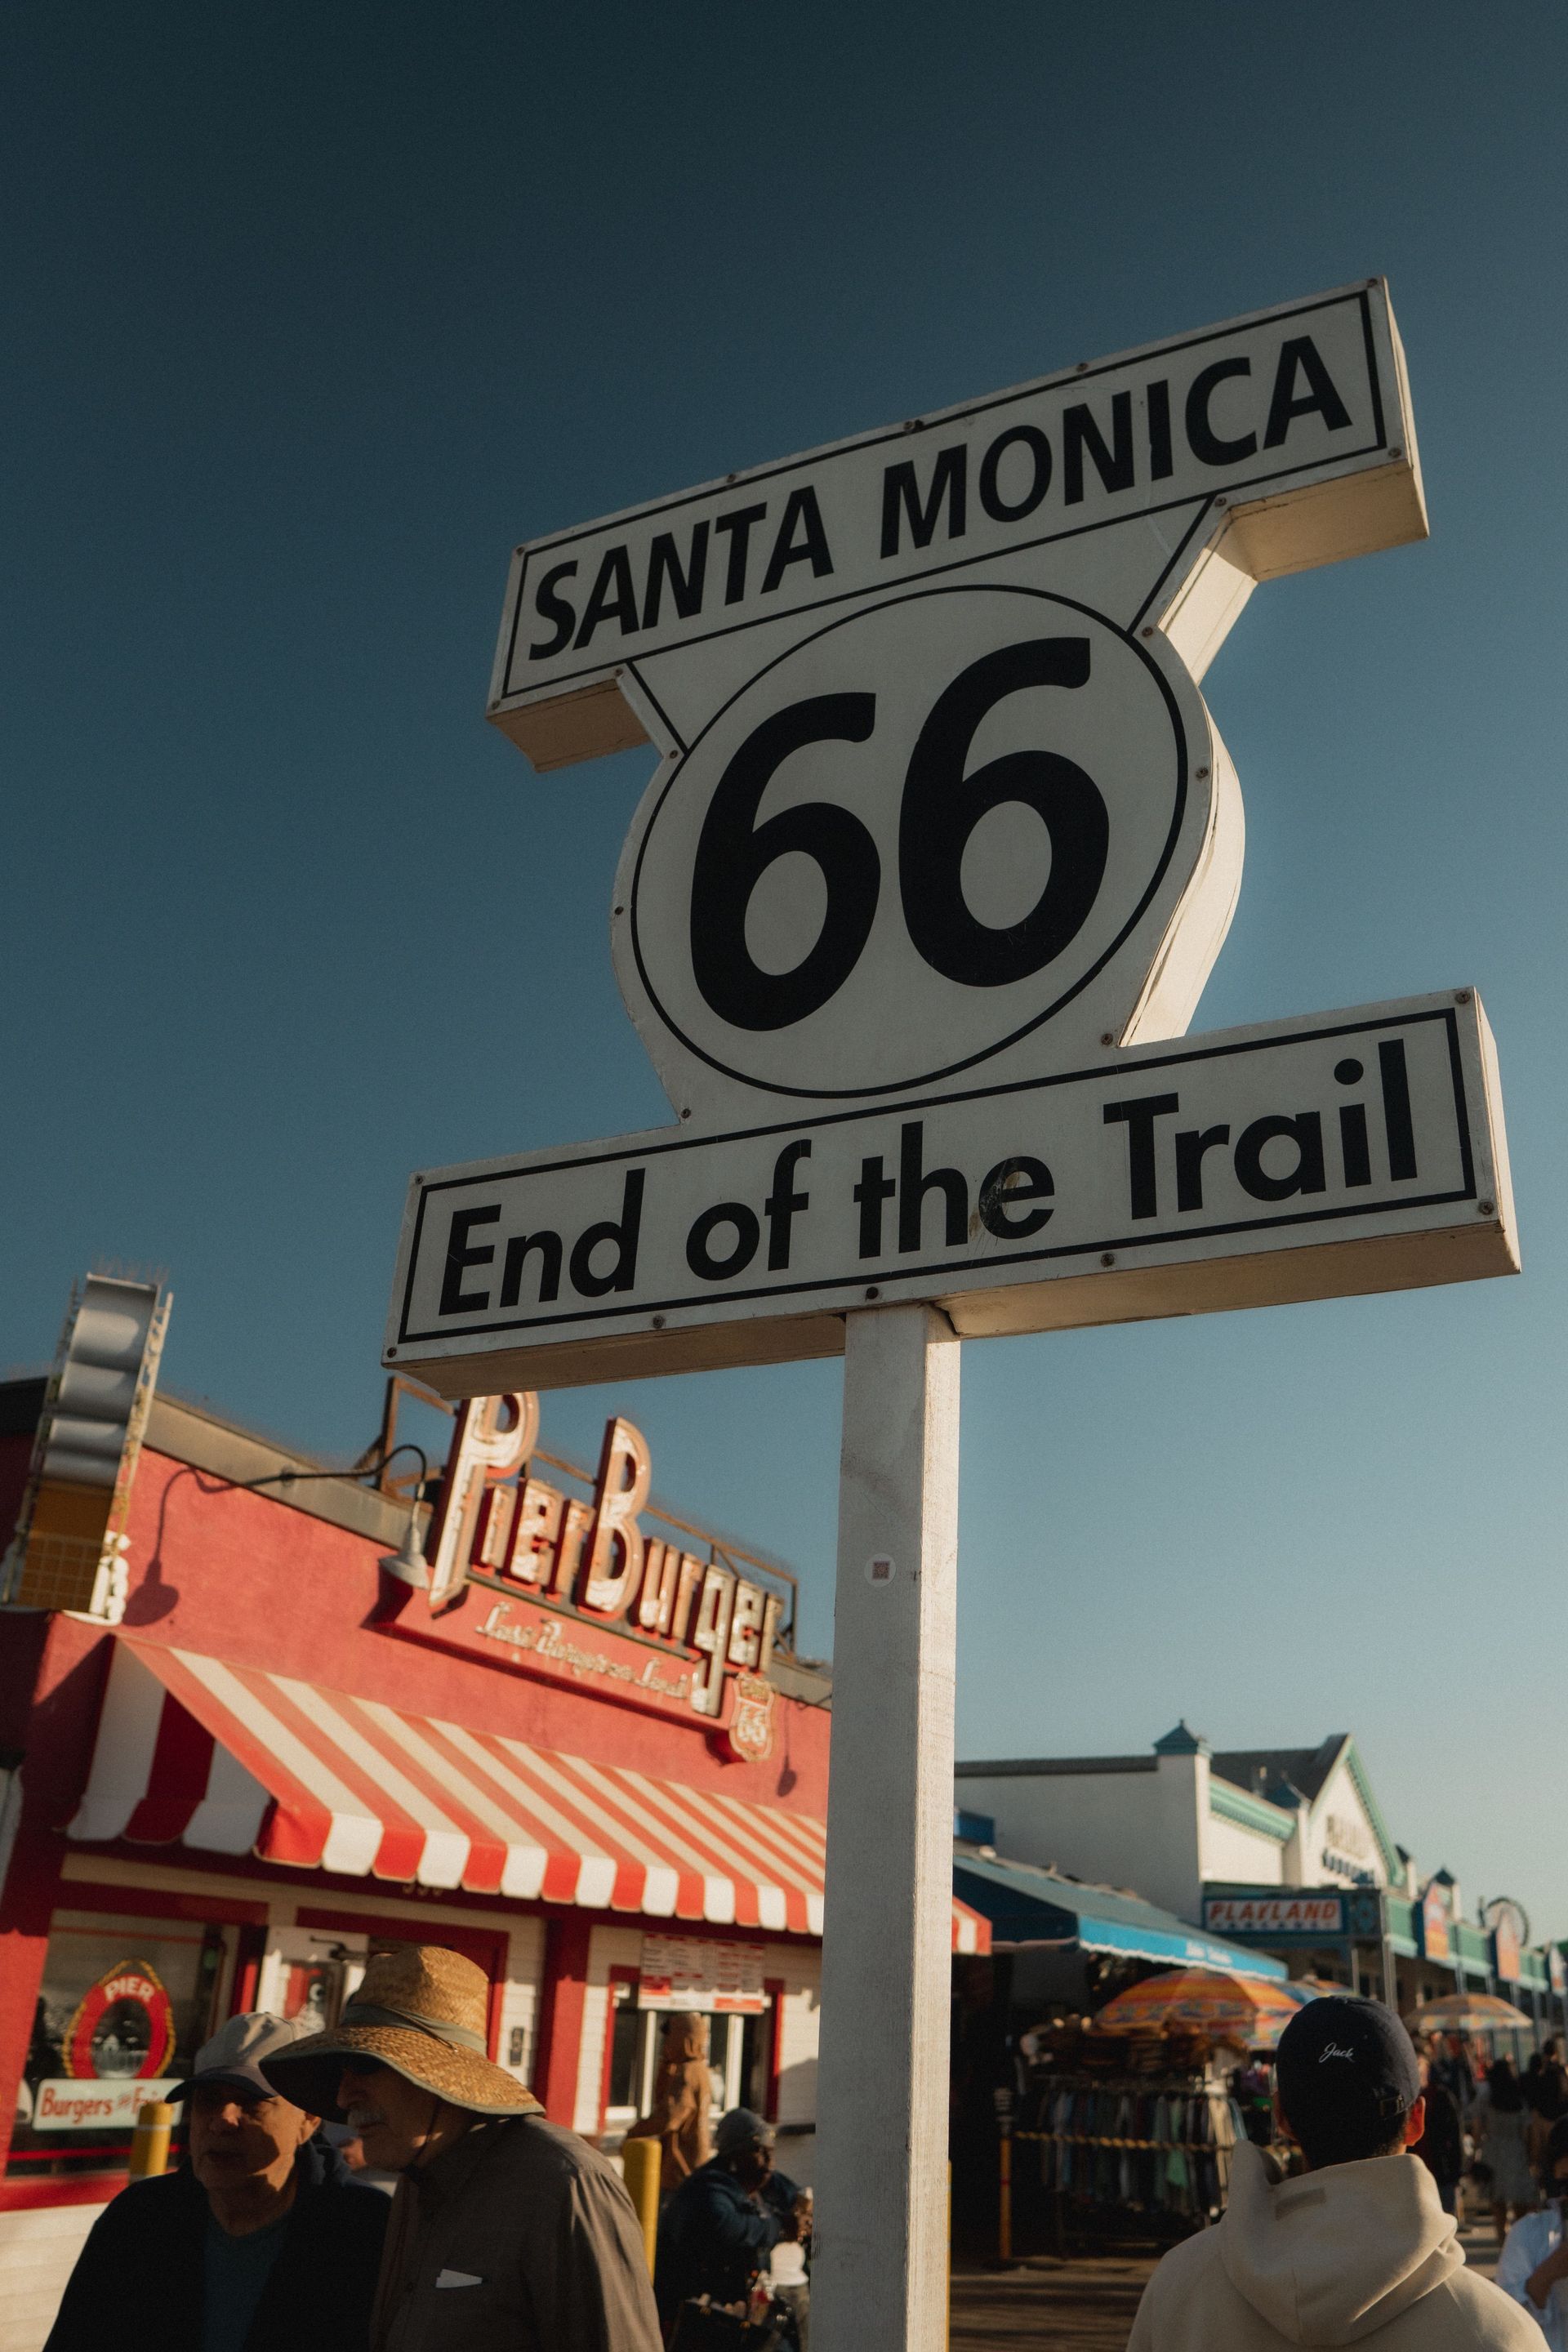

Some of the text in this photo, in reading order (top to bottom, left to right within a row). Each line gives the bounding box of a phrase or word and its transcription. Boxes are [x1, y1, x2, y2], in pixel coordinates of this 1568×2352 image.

[528, 335, 1353, 661] SANTA MONICA
[689, 636, 1110, 1032] 66
[438, 1038, 1418, 1316] End of the Trail
[1209, 1901, 1338, 1921] PLAYLAND
[104, 1976, 155, 2003] PIER
[1318, 2041, 1356, 2063] Jack
[41, 2087, 114, 2125] Burgers
